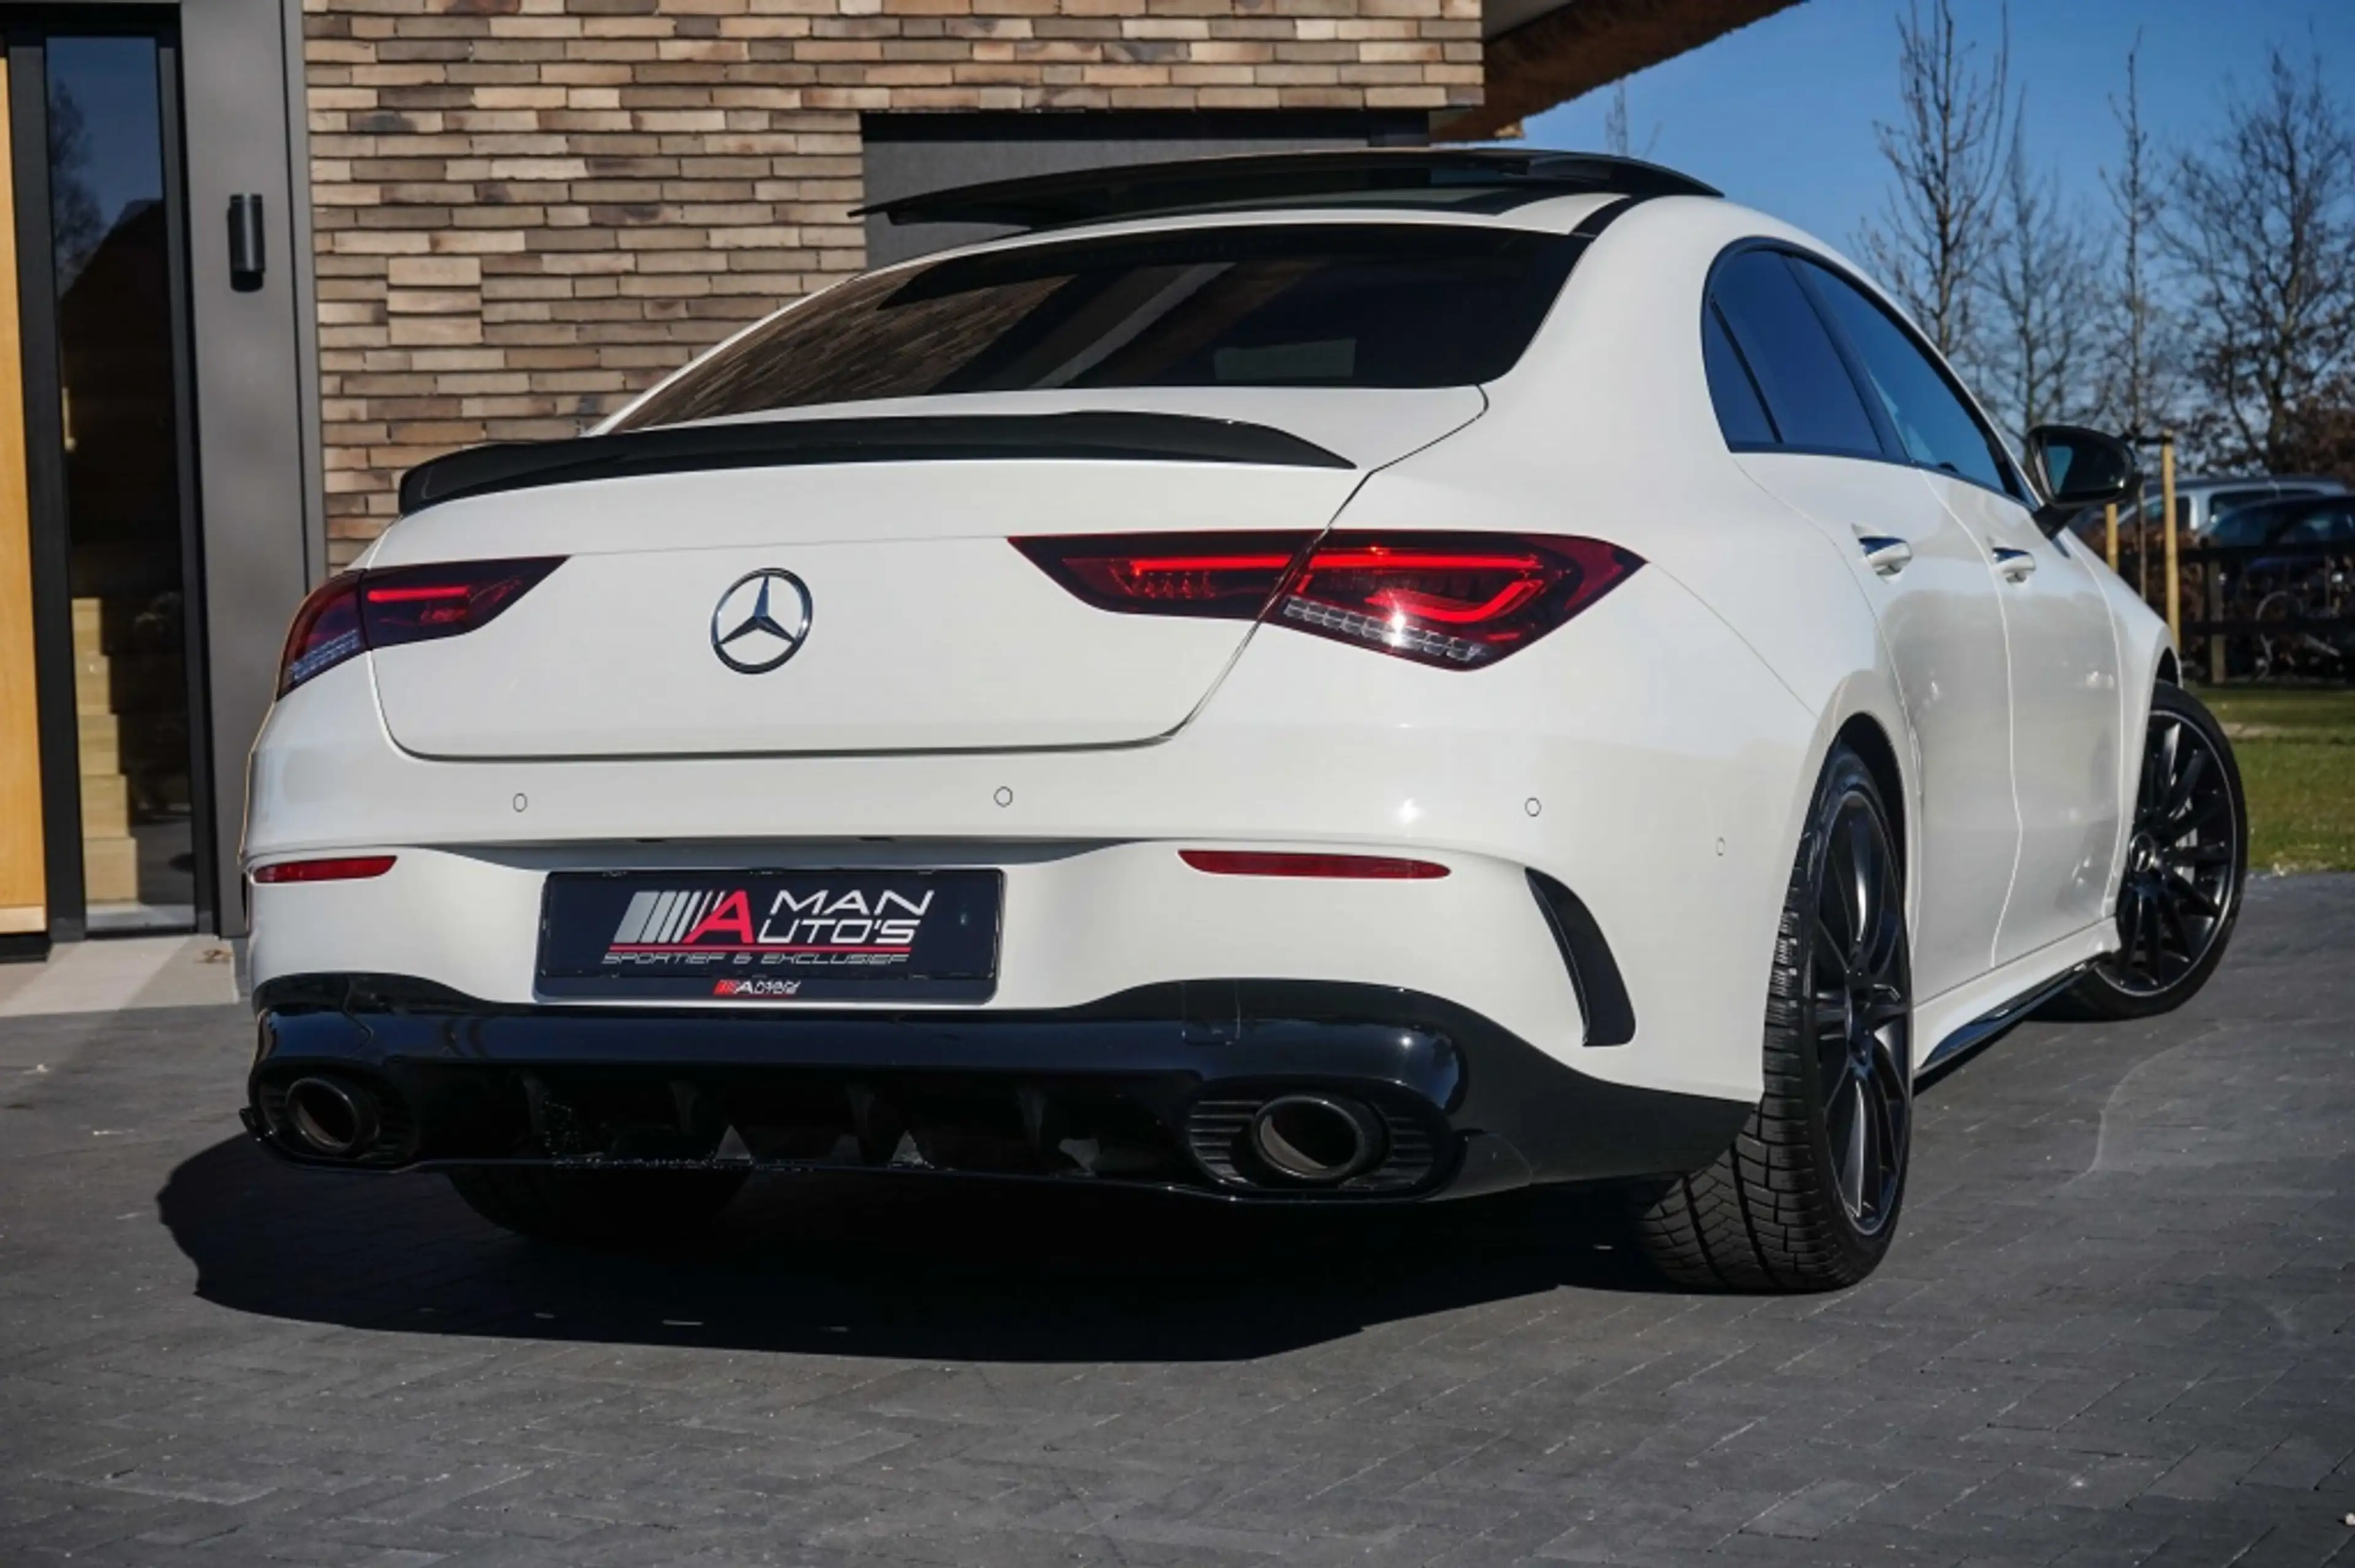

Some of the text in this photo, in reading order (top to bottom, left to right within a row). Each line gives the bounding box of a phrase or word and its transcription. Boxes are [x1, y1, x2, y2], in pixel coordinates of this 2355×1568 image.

[601, 952, 910, 965] SPORTIEF & EXCLUSIEF
